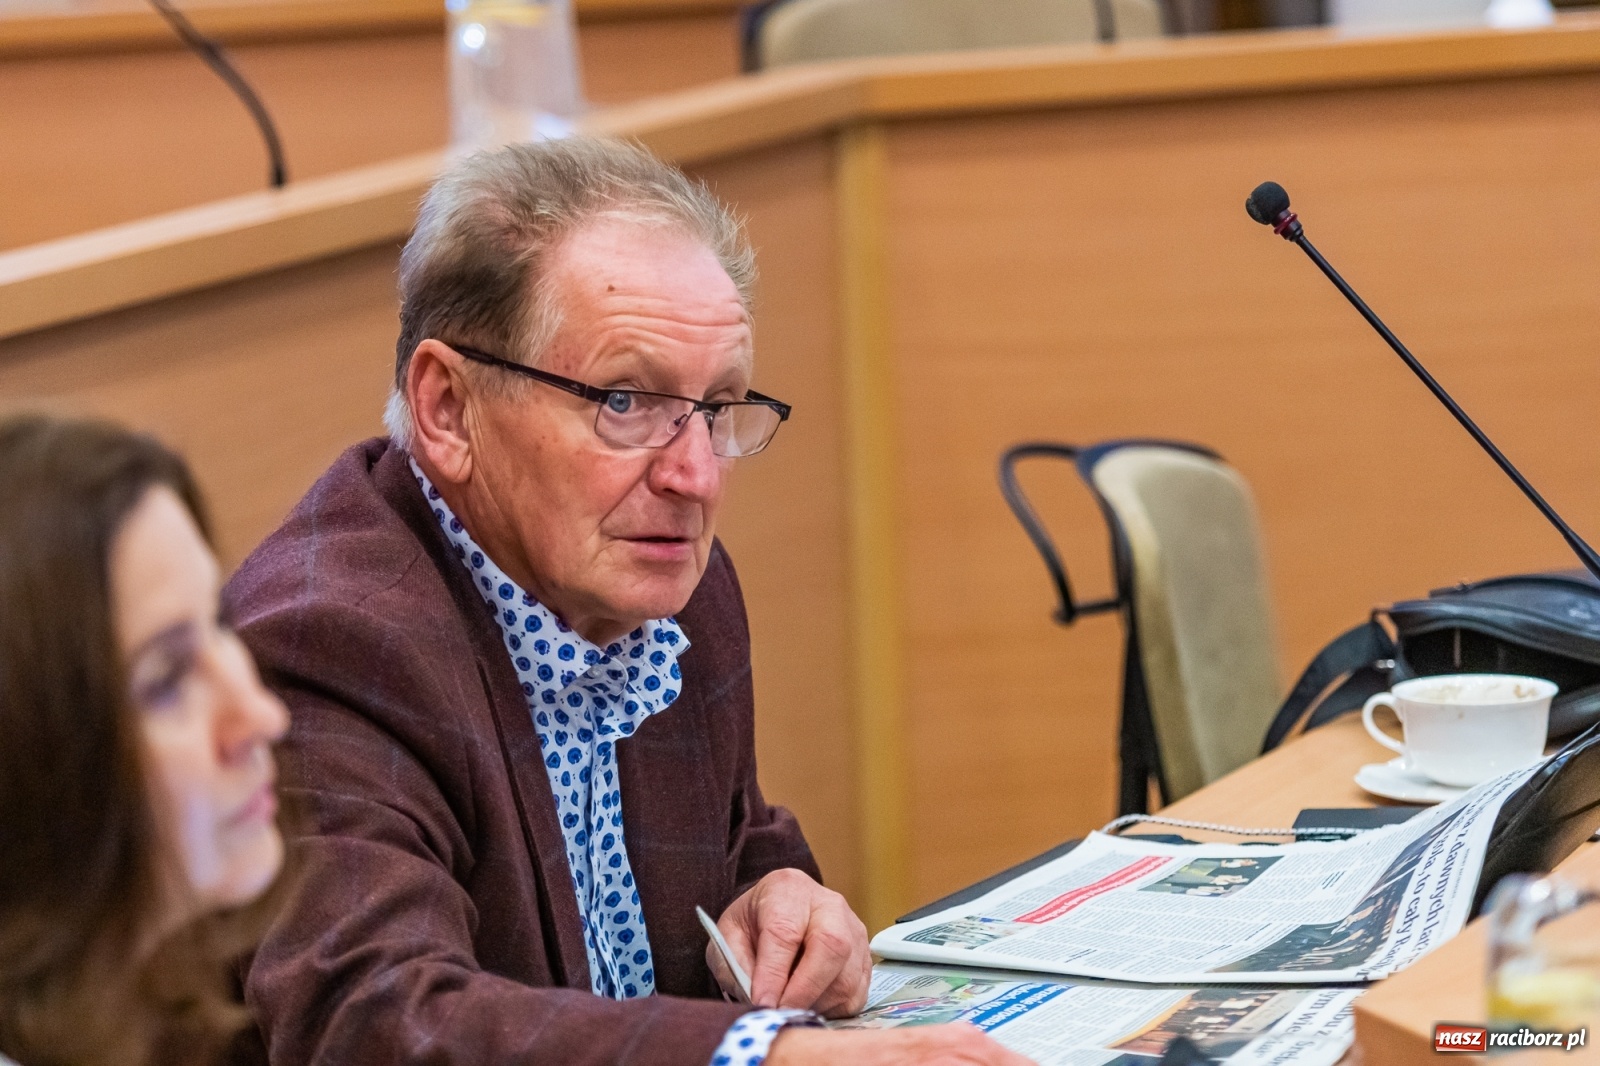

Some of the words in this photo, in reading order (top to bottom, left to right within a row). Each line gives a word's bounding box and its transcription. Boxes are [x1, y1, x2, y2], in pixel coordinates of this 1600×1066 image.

[1413, 874, 1431, 896] to
[1426, 841, 1465, 923] dawnych
[1396, 896, 1421, 935] cały
